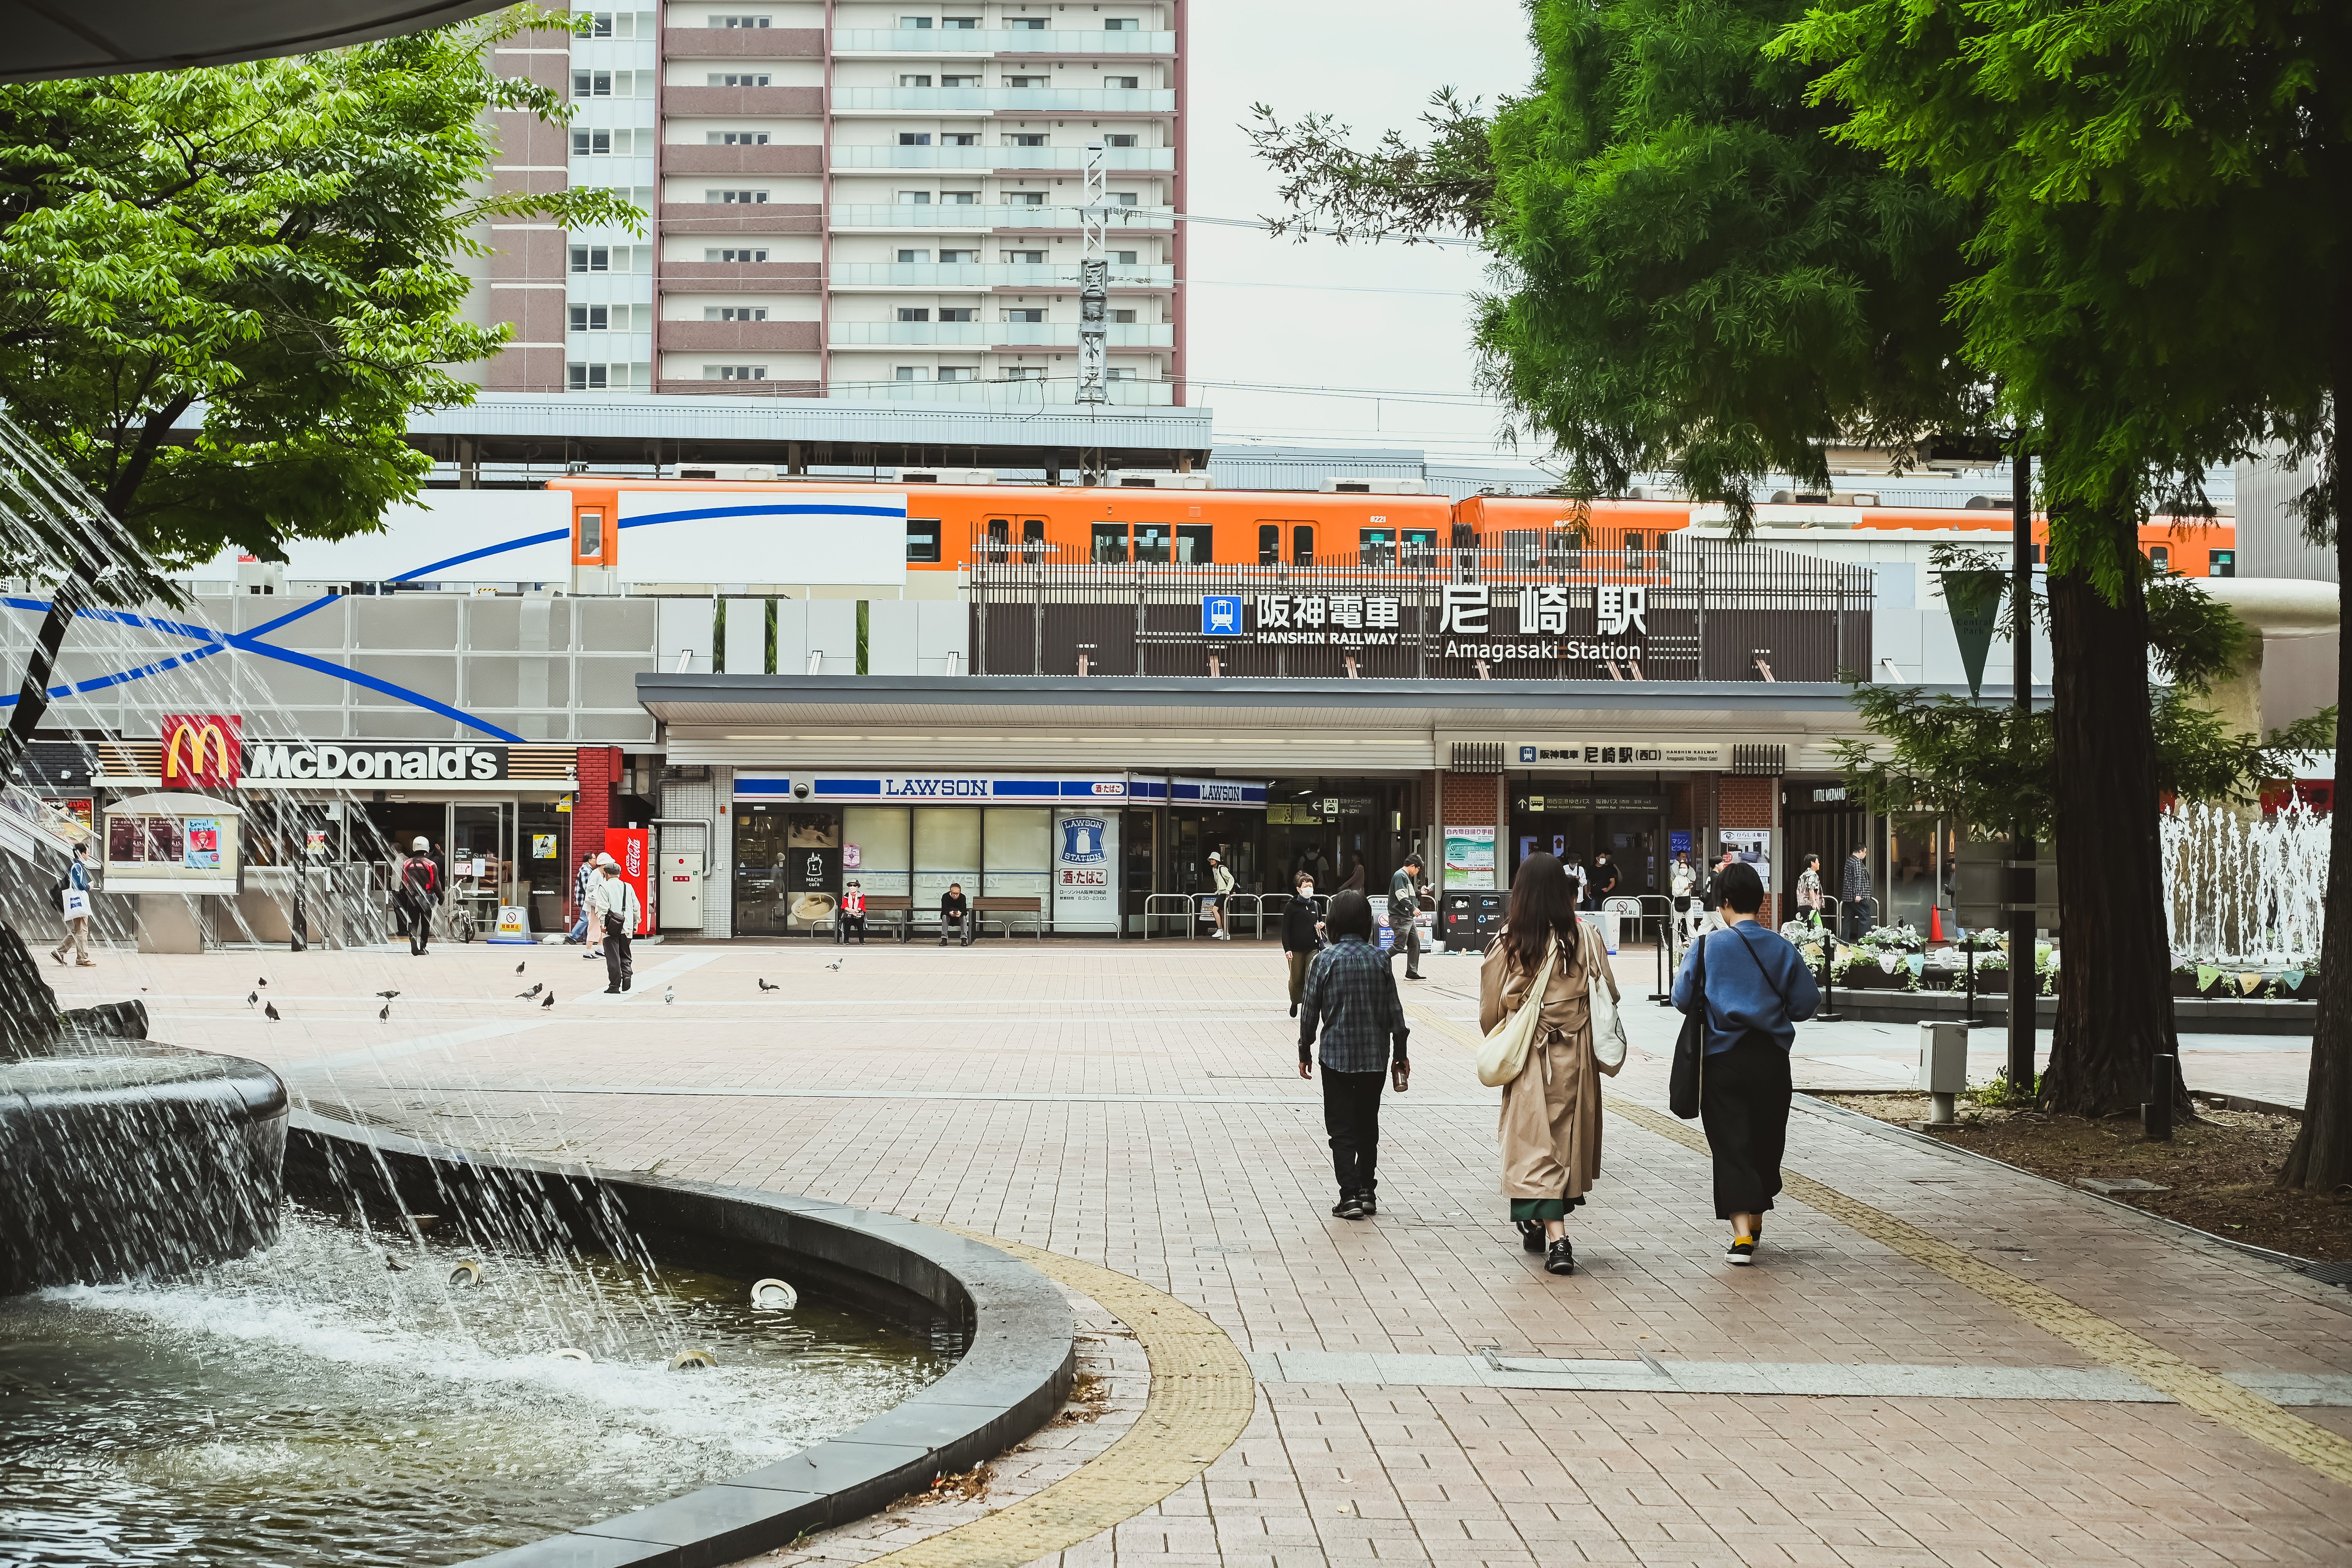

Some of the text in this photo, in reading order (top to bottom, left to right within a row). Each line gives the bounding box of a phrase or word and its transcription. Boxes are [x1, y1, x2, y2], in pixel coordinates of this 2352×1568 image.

[1257, 595, 1399, 629] 阪神電車
[1440, 585, 1646, 635] 尼崎駅
[1257, 632, 1399, 645] HANSHIN RAILWAY
[1445, 640, 1641, 662] Amagasaki Station
[250, 746, 498, 779] McDonald's
[1540, 749, 1579, 760] 阪神電車
[886, 779, 988, 796] LAWSON
[1202, 784, 1240, 801] LAWSON
[1813, 787, 1846, 802] LITTLE MERMAID
[1064, 819, 1103, 829] LAWSON
[1064, 852, 1102, 862] STATION
[1063, 871, 1104, 884] 酒・たばこ
